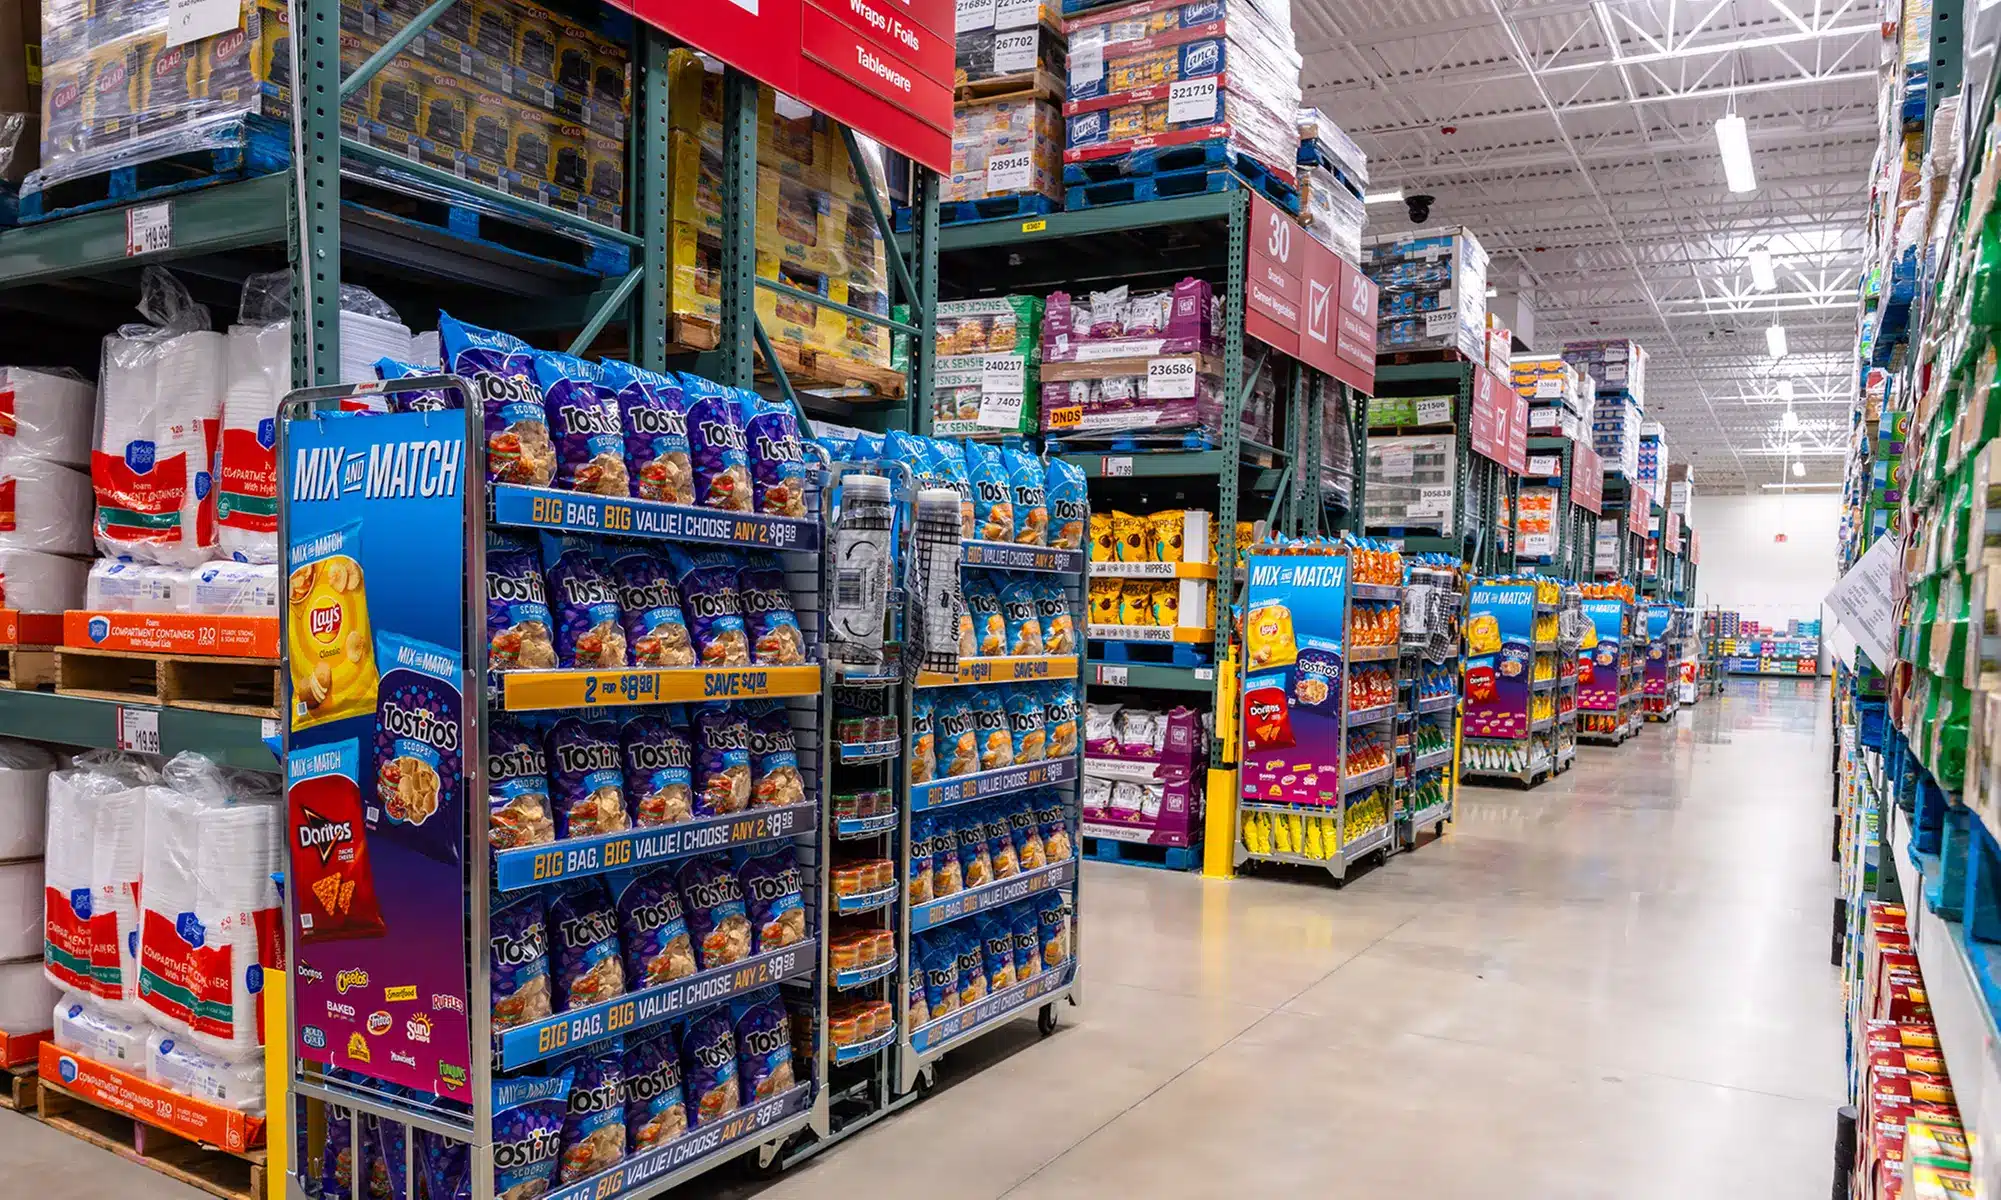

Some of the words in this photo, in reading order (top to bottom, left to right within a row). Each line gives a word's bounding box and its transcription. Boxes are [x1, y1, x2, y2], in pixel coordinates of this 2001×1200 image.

[528, 7, 549, 20] GLAD
[565, 27, 586, 39] GLAD
[851, 0, 886, 30] Wraps
[894, 20, 919, 51] Foils
[217, 32, 245, 59] GLAD
[996, 36, 1033, 50] 267702
[156, 50, 182, 77] GLAD
[1184, 44, 1218, 68] Lance
[855, 46, 911, 92] Tableware
[101, 66, 125, 92] GLAD
[434, 75, 457, 88] GLAD
[55, 84, 78, 108] GLAD
[480, 94, 502, 105] GLAD
[1171, 84, 1215, 99] 321719
[521, 111, 543, 122] GLAD
[561, 125, 581, 137] GLAD
[1071, 115, 1100, 138] Lance
[991, 156, 1030, 171] 289145
[145, 224, 168, 250] $19.99
[1268, 212, 1290, 263] 30
[1352, 275, 1369, 317] 29
[1428, 312, 1457, 322] 325757
[985, 361, 1022, 371] 240217
[1150, 364, 1194, 375] 236586
[984, 397, 1021, 407] 27403
[1052, 410, 1081, 424] DNDS
[293, 446, 345, 501] MIX
[344, 460, 365, 487] AND
[364, 439, 462, 499] MATCH
[1422, 489, 1451, 498] 305838
[532, 497, 562, 523] BIG
[566, 503, 599, 530] BAG,
[604, 503, 631, 531] BIG
[636, 510, 682, 536] VALUE!
[685, 516, 731, 540] CHOOSE
[734, 520, 758, 542] ANY
[292, 541, 309, 564] MIX
[314, 532, 343, 557] MATCH
[967, 548, 981, 563] BIG
[983, 550, 1009, 565] VALUE!
[1008, 549, 1034, 566] CHOOSE
[1035, 553, 1048, 568] ANY
[1144, 563, 1172, 574] HIPPEAS
[1252, 565, 1280, 586] MIX
[1292, 565, 1344, 587] MATCH
[1471, 591, 1491, 605] MIX
[1498, 591, 1532, 605] MATCH
[1595, 604, 1621, 614] MATCH
[312, 607, 341, 633] Lay's
[112, 627, 155, 639] COMPARTMENT
[155, 628, 195, 641] CONTAINERS
[199, 627, 216, 640] 120
[1144, 630, 1171, 640] HIPPEAS
[319, 646, 342, 660] Classic
[397, 644, 415, 666] MIX
[422, 650, 454, 678] MATCH
[1014, 662, 1033, 678] SAVE
[585, 676, 598, 703] 2
[602, 682, 616, 694] FOR
[704, 675, 739, 697] SAVE
[1250, 704, 1281, 717] Doritos
[383, 702, 458, 751] TOSTITOS
[135, 730, 159, 753] $19.99
[291, 759, 308, 778] MIX
[314, 751, 342, 775] MATCH
[928, 787, 944, 806] BIG
[962, 781, 977, 798] BIG
[1003, 772, 1028, 790] CHOOSE
[1028, 769, 1042, 785] ANY
[300, 821, 353, 847] Doritos
[533, 851, 563, 880] BIG
[567, 846, 600, 872] BAG,
[604, 839, 631, 867] BIG
[635, 831, 681, 860] VALUE!
[684, 824, 729, 851] CHOOSE
[732, 821, 755, 840] ANY
[298, 965, 324, 980] Doritos
[337, 969, 368, 993] Cheetos
[326, 1000, 356, 1016] BAKED
[432, 994, 465, 1013] RUFFLES
[538, 1024, 568, 1053] BIG
[571, 1020, 604, 1043] BAG,
[607, 1001, 635, 1030] BIG
[638, 989, 685, 1020] VALUE!
[686, 973, 731, 1005] CHOOSE
[734, 968, 757, 991] ANY
[157, 1099, 172, 1114] 120
[595, 1170, 624, 1200] BIG
[627, 1149, 673, 1186] VALUE!
[673, 1129, 719, 1164] CHOOSE
[720, 1123, 744, 1144] ANY
